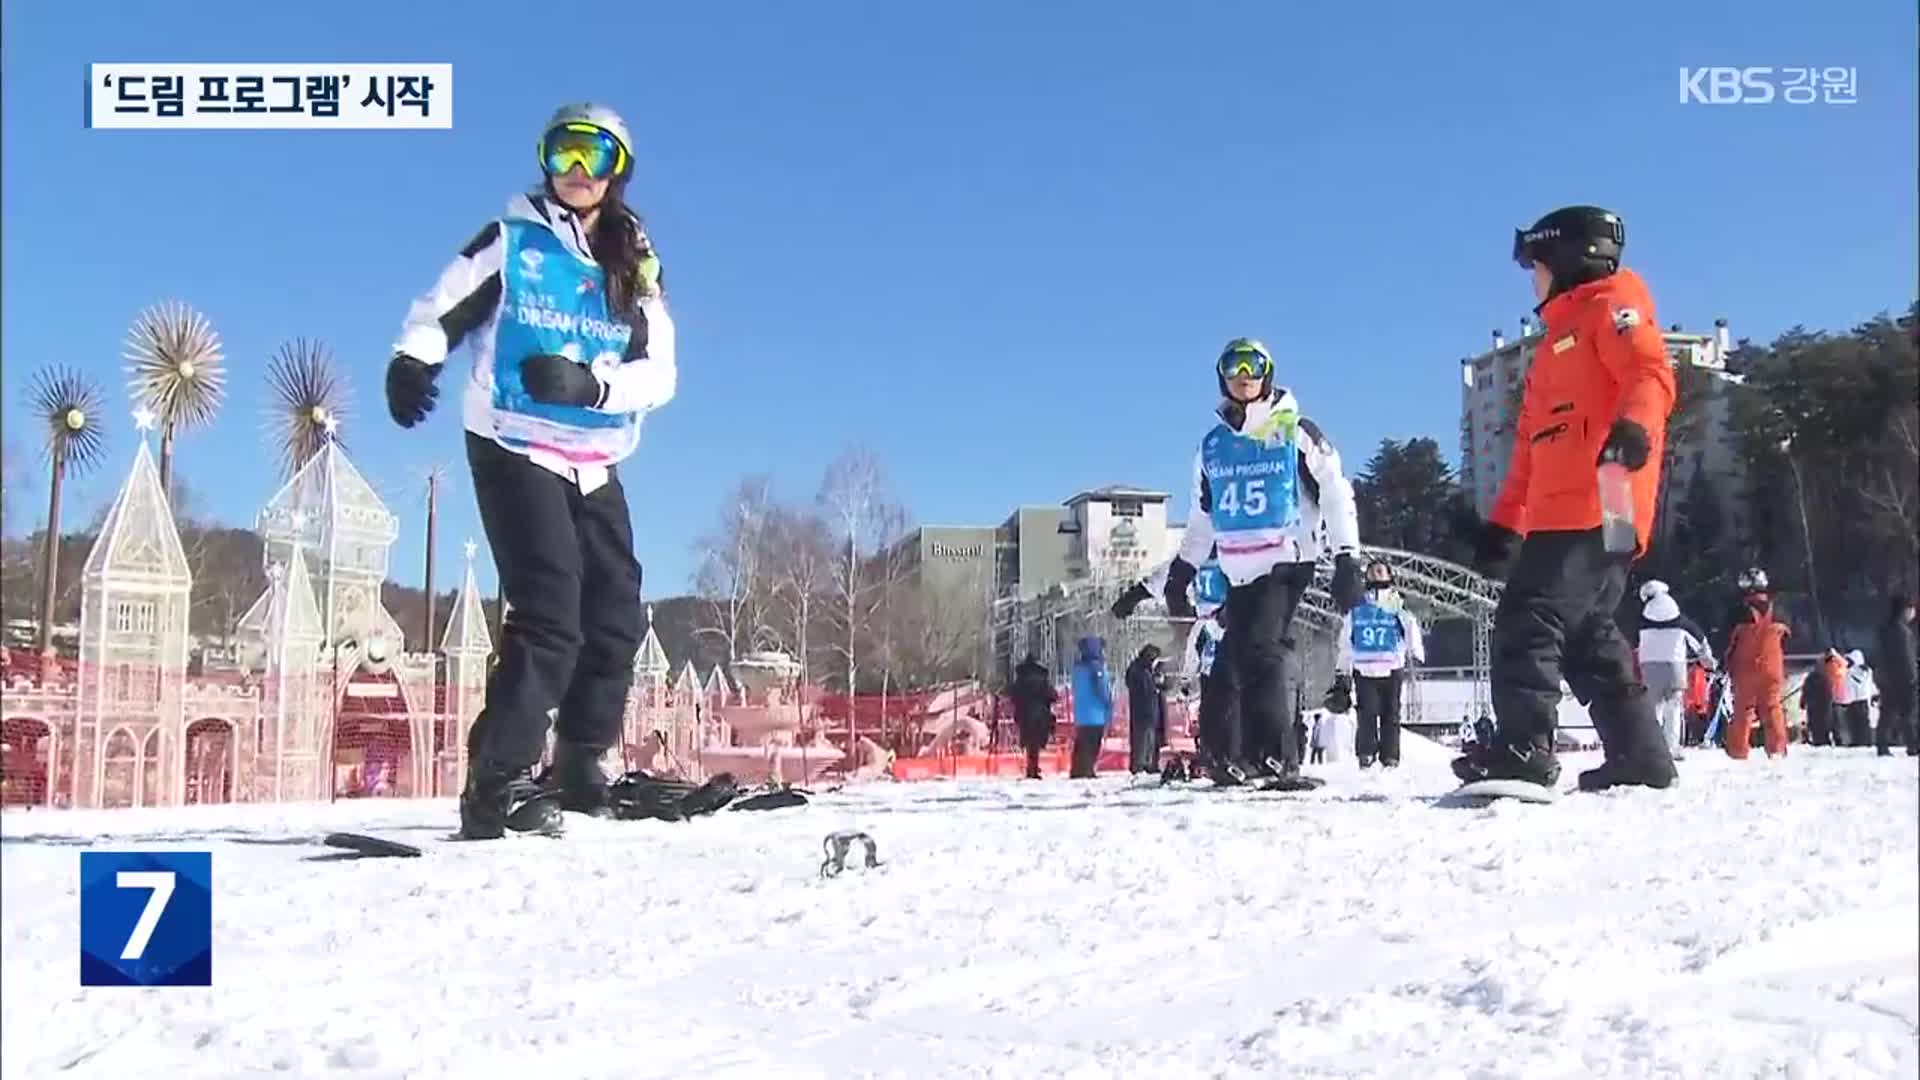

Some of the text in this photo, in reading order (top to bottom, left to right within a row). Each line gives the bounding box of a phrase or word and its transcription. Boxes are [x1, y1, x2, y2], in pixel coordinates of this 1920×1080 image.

[1524, 228, 1561, 243] SMITH
[1236, 460, 1286, 477] PROGRAM
[1218, 479, 1268, 517] 45
[1361, 626, 1387, 648] 97
